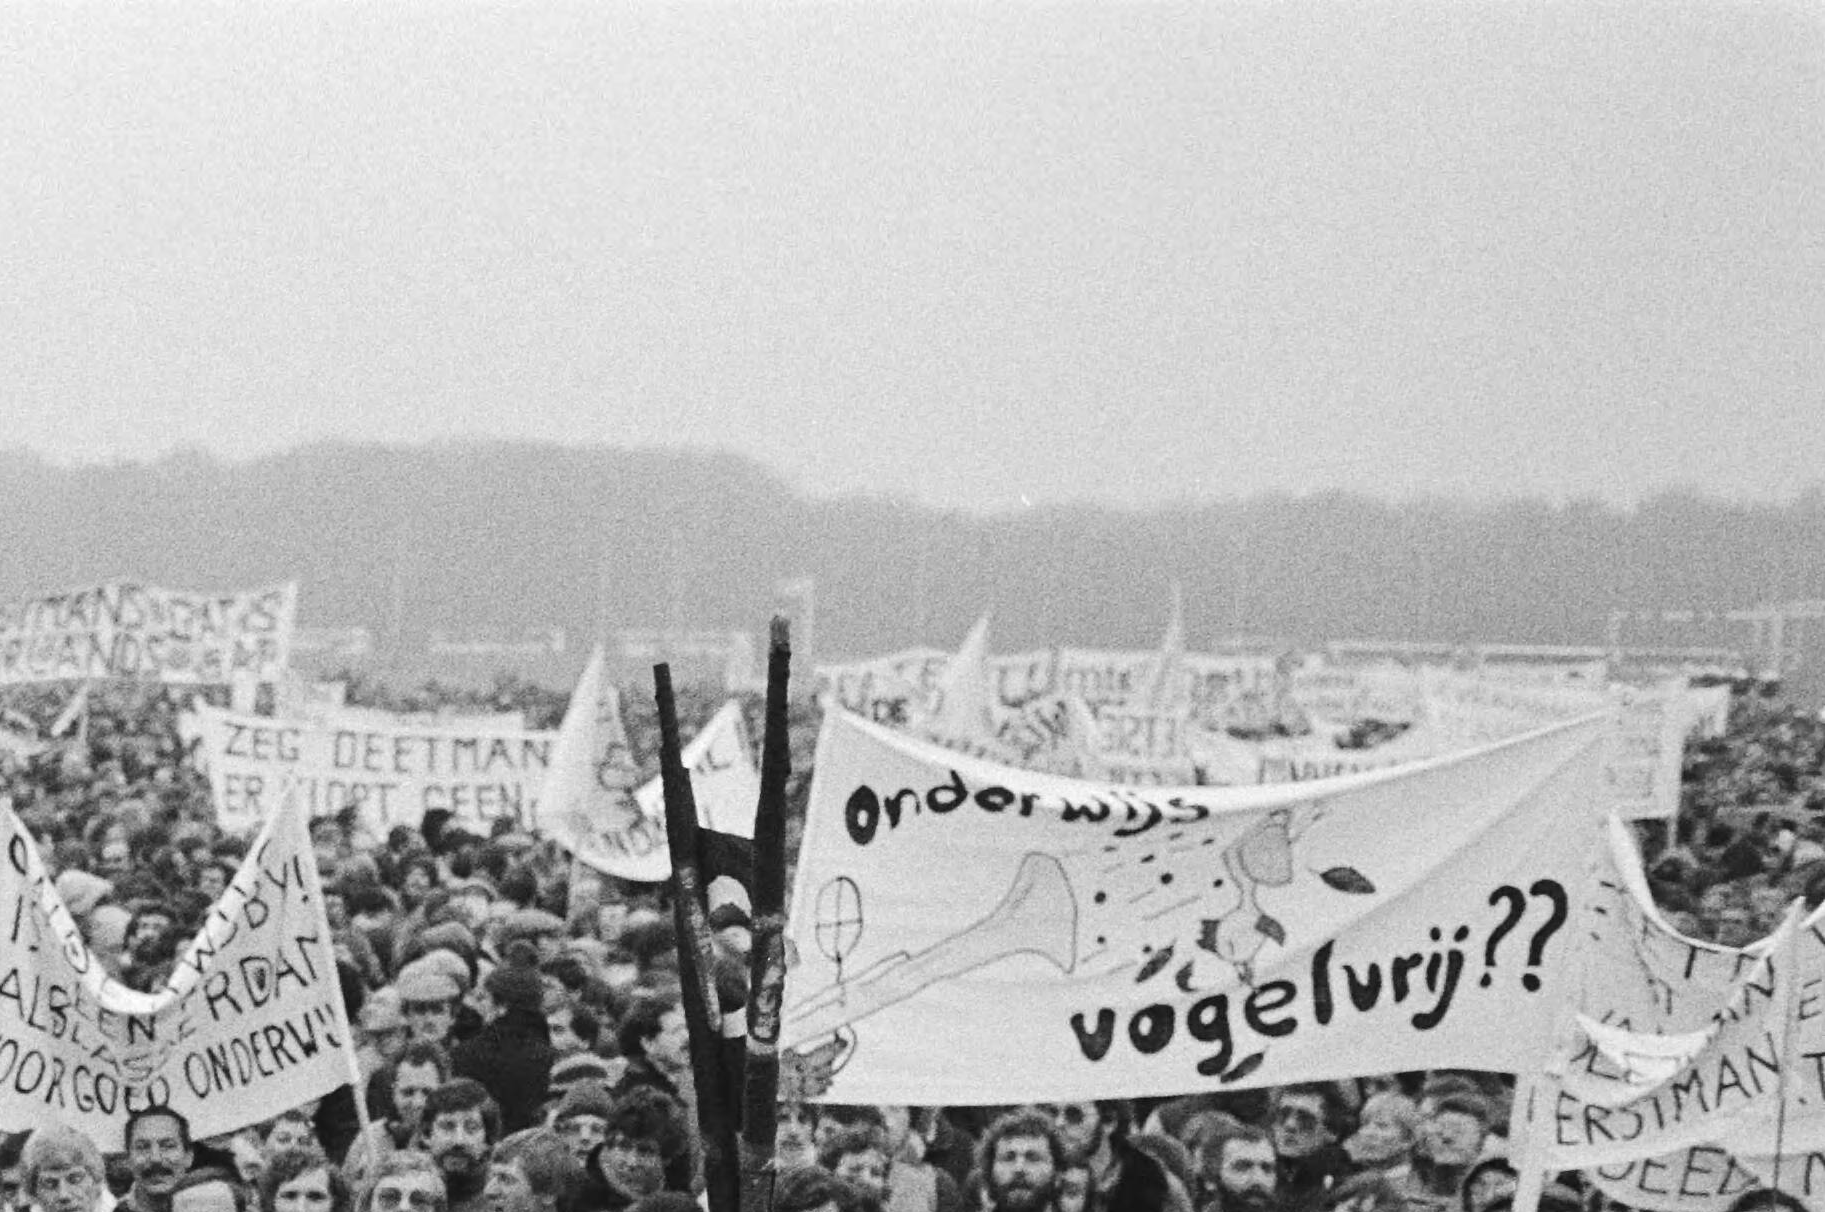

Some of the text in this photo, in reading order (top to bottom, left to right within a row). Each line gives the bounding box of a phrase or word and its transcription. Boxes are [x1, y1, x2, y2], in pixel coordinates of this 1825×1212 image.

[223, 721, 551, 774] ZEG DEETMAN
[224, 773, 265, 816] ER
[845, 769, 1210, 846] Onderwijs
